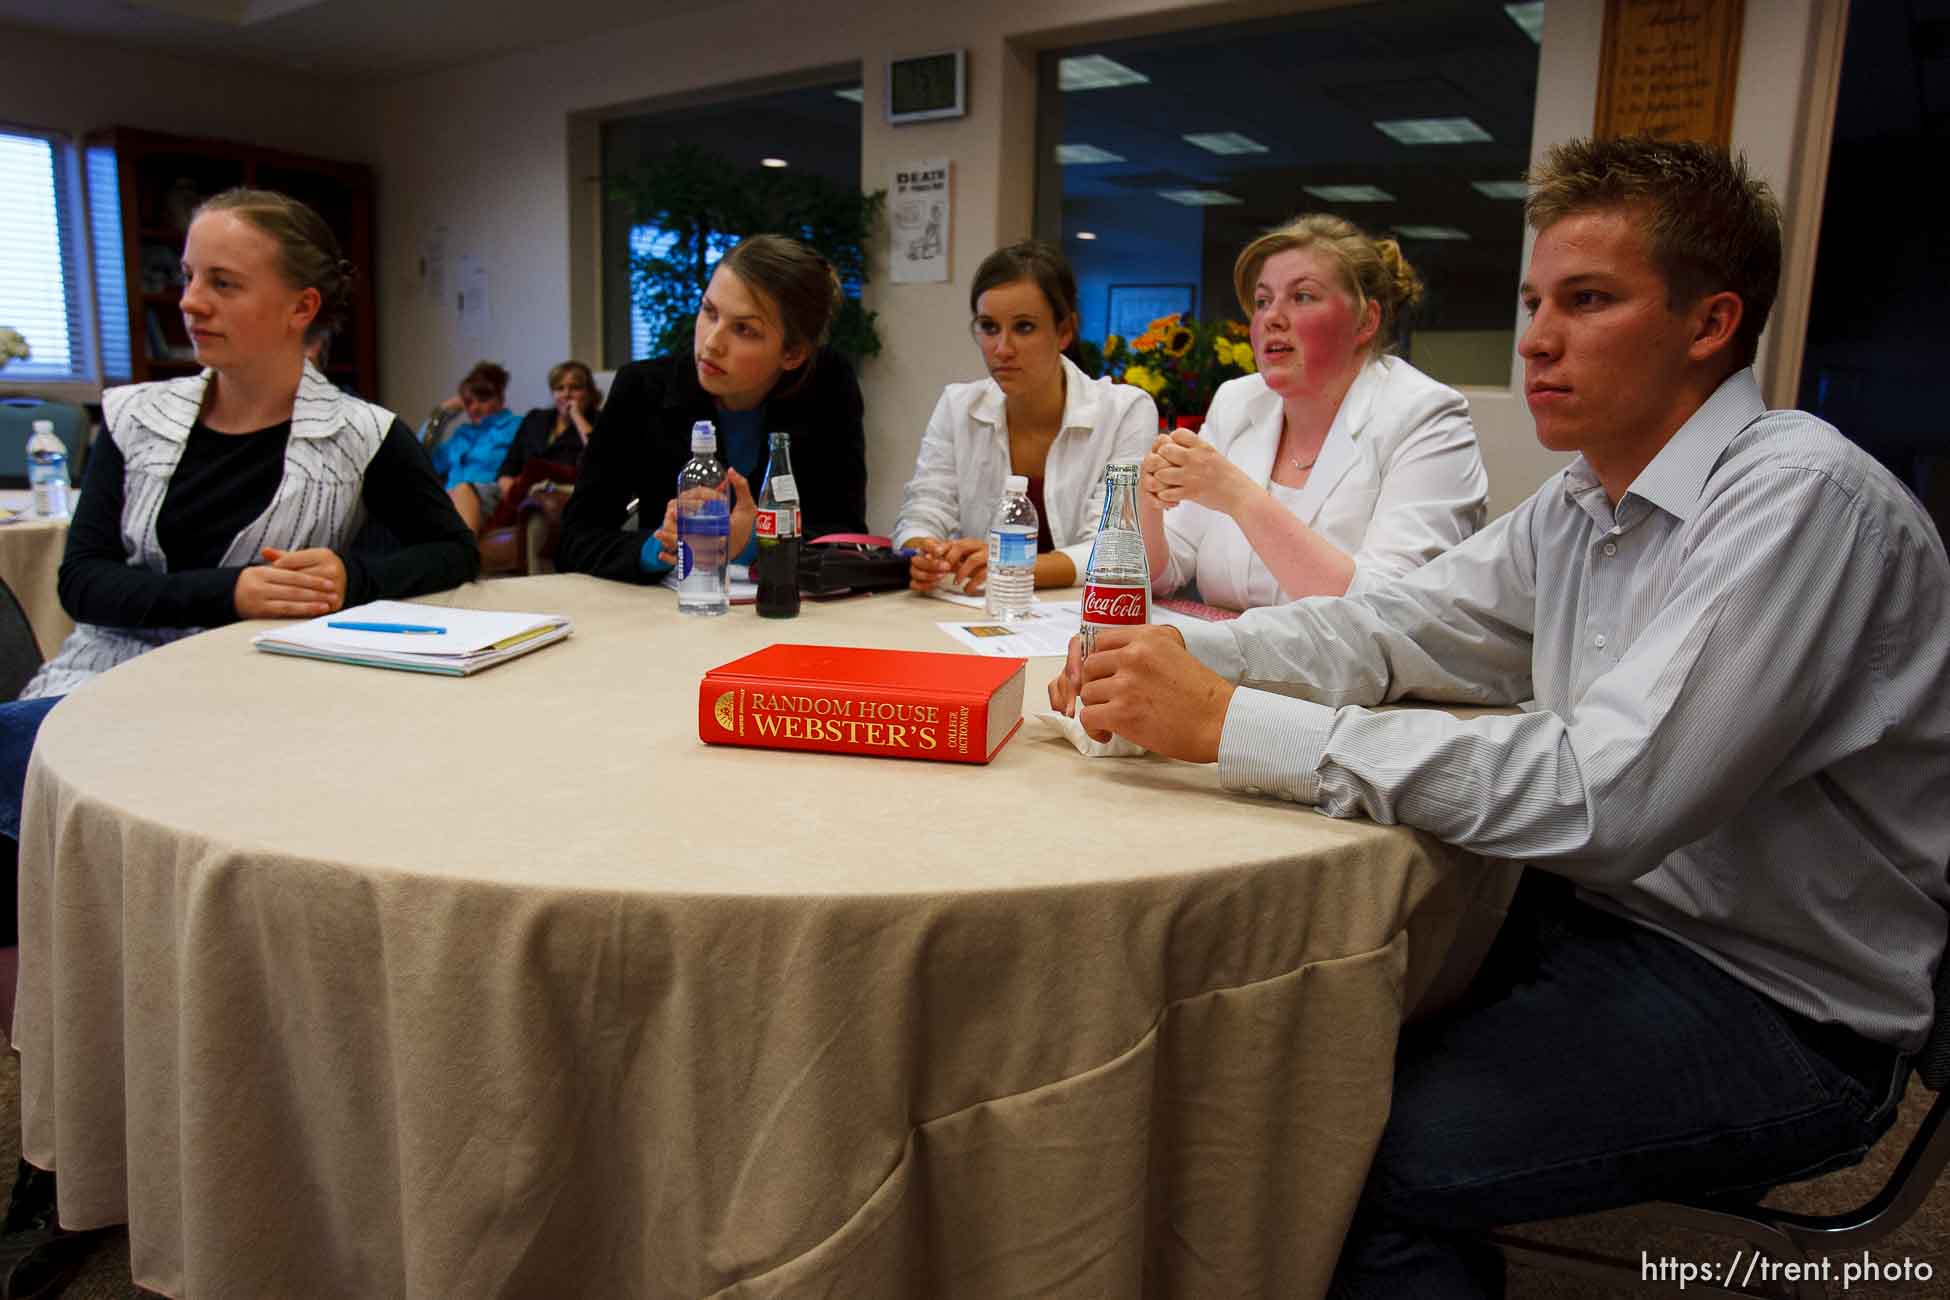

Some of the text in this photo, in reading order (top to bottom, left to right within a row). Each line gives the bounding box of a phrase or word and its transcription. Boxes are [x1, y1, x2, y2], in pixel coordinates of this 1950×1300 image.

[1084, 591, 1143, 618] Coca-Cola
[752, 693, 940, 724] RANDOM HOUSE
[751, 713, 938, 750] WEBSTER'S
[947, 711, 958, 748] COLLEGE
[958, 705, 969, 754] DICTIONARY
